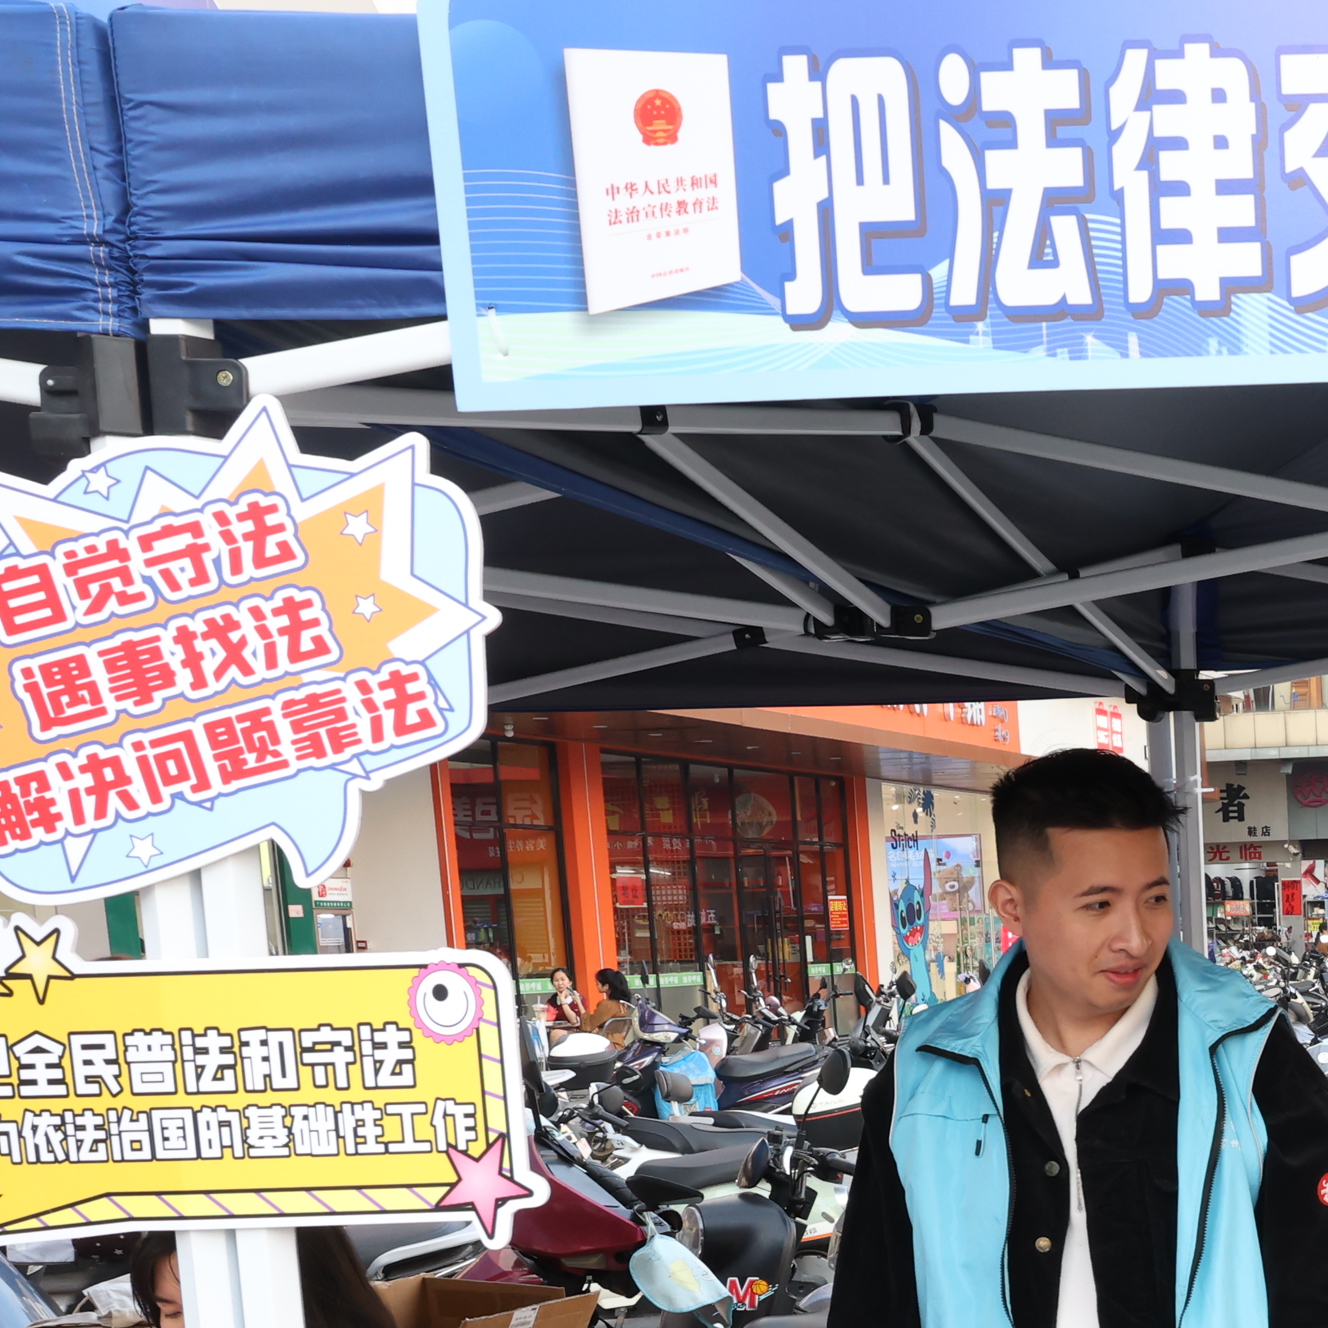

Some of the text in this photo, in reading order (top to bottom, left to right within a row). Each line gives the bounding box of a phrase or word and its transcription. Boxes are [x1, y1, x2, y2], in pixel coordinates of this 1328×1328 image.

[605, 172, 718, 201] 中华人民共和国
[607, 195, 719, 226] 法治宣传教育法
[0, 498, 299, 638] 自觉守法
[20, 595, 333, 733] 遇事找法
[0, 670, 440, 846] 解决问题靠法
[1215, 783, 1250, 823] 者
[1247, 825, 1271, 837] 鞋店
[1207, 843, 1264, 862] 光临
[0, 1022, 418, 1099] 全民普法和守法
